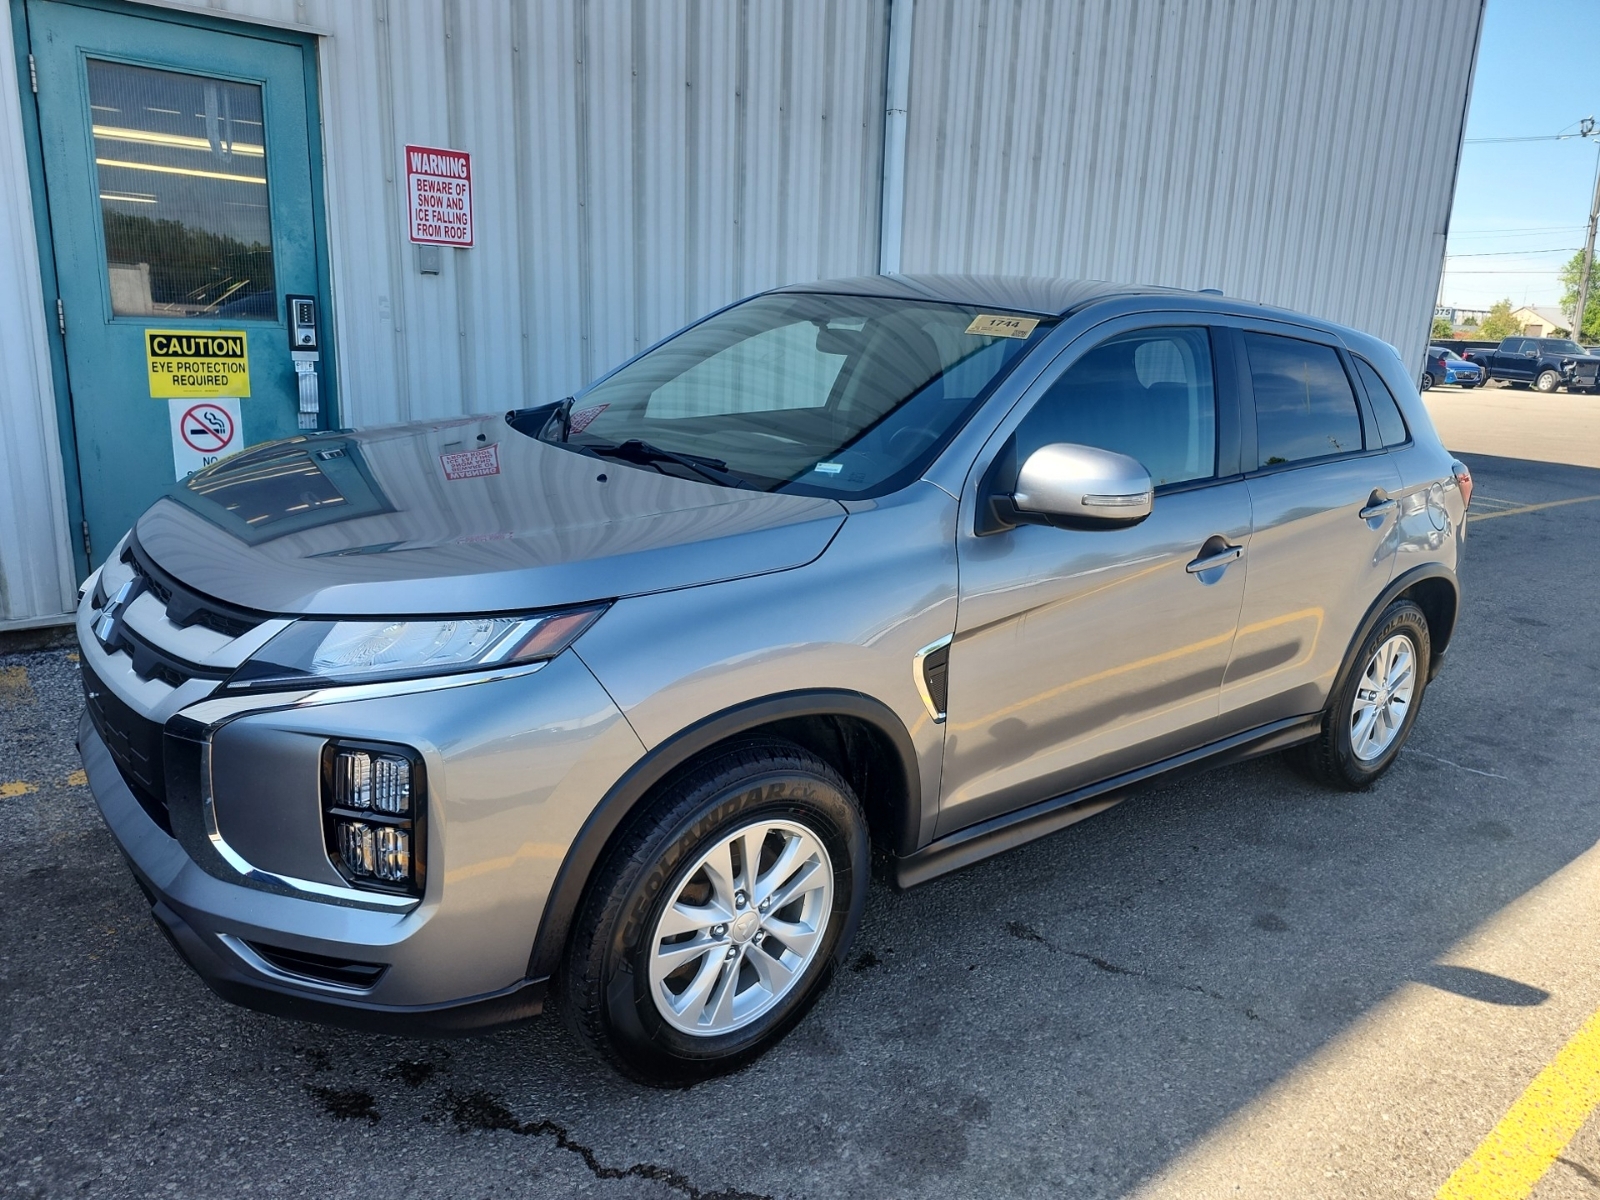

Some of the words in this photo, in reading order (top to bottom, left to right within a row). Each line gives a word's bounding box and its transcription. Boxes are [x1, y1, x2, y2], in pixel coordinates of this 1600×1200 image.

[410, 152, 467, 178] WARNING
[417, 179, 452, 195] BEWARE
[456, 183, 466, 196] OF
[418, 194, 443, 208] SNOW
[446, 197, 463, 211] AND
[415, 208, 429, 222] ICE
[432, 210, 467, 225] FALLING
[417, 223, 441, 237] FROM
[444, 226, 467, 239] ROOF
[989, 319, 1020, 328] 1744
[153, 337, 241, 355] CAUTION
[152, 361, 173, 373] EYE
[177, 361, 246, 373] PROTECTION
[172, 375, 228, 386] REQUIRED
